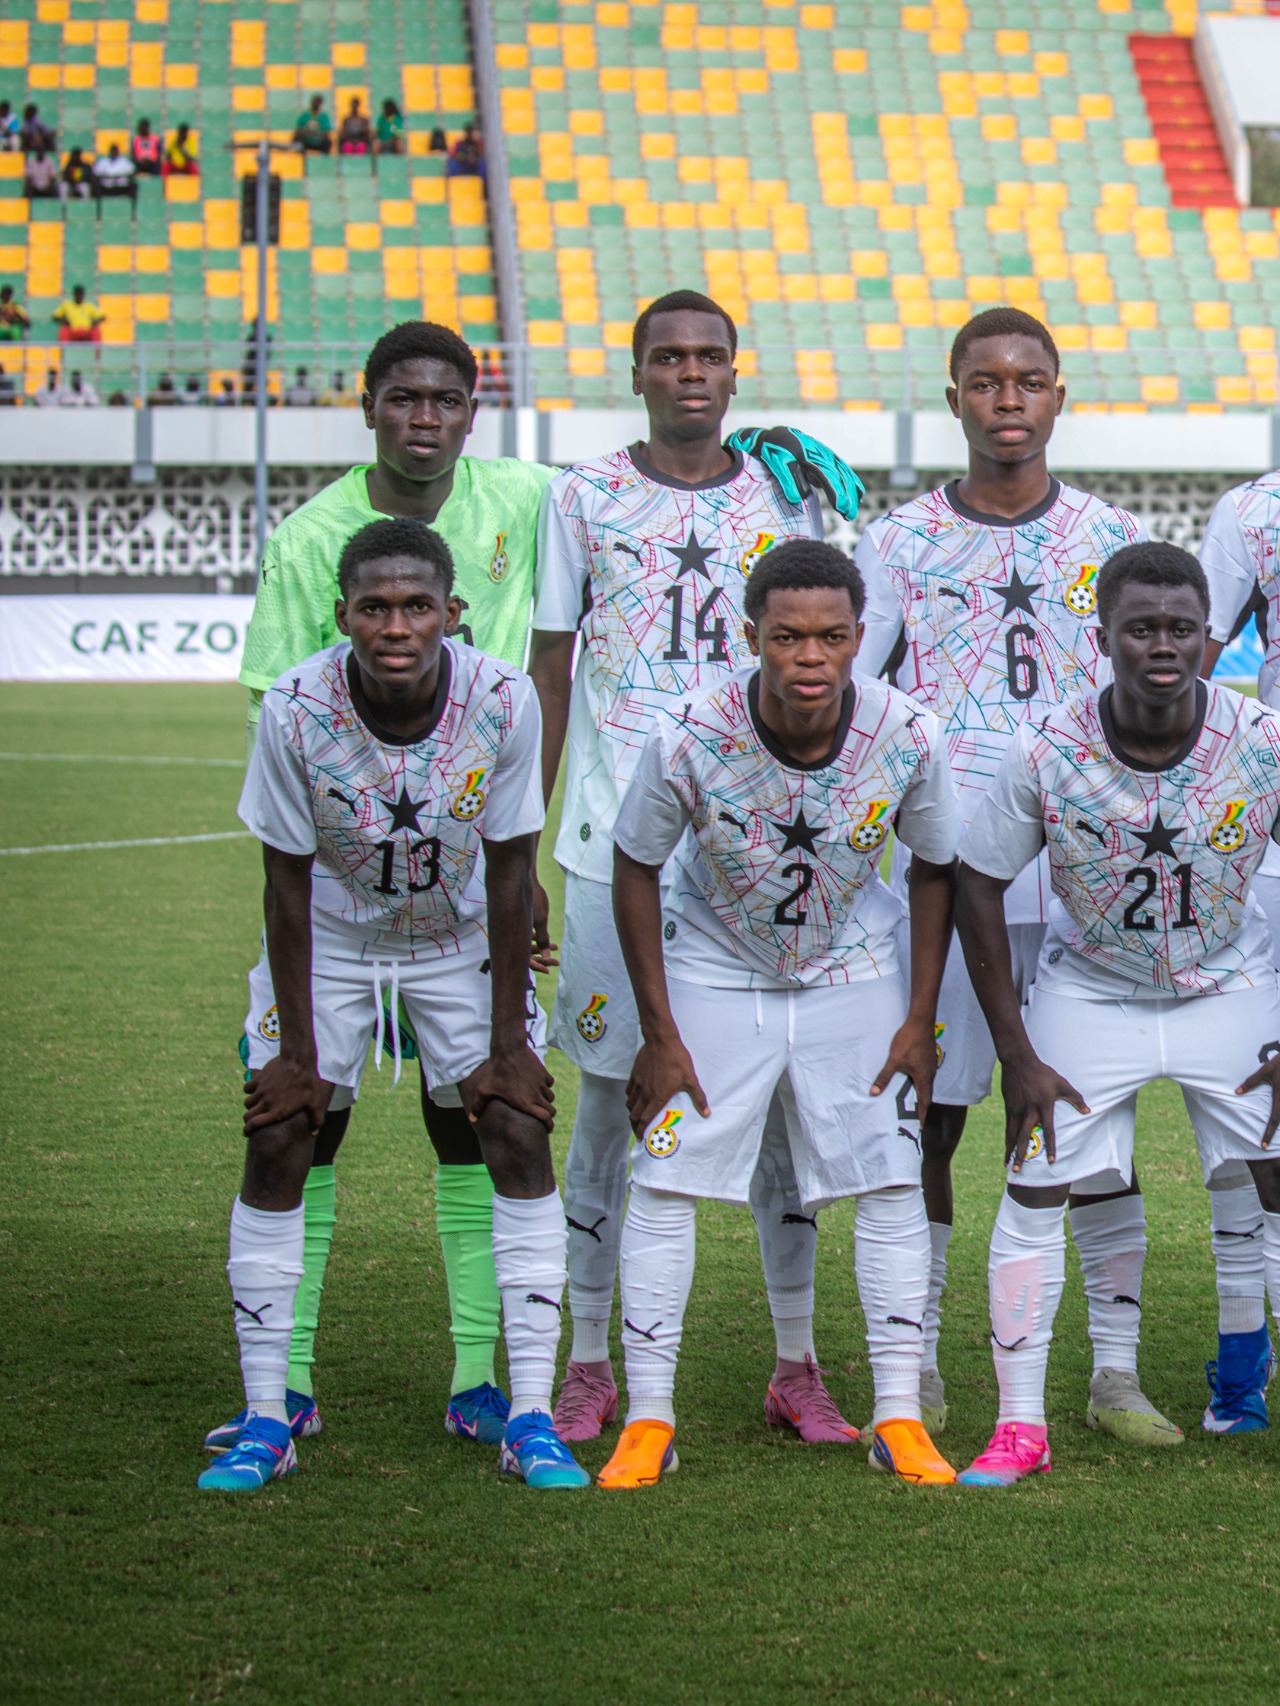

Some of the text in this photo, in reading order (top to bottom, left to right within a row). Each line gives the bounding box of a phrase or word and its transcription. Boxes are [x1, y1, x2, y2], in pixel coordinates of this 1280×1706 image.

[70, 620, 250, 654] CAF ZO
[663, 586, 727, 661] 14
[1005, 623, 1039, 699] 6
[371, 836, 443, 896] 13
[773, 862, 814, 927] 2
[1122, 864, 1201, 931] 21
